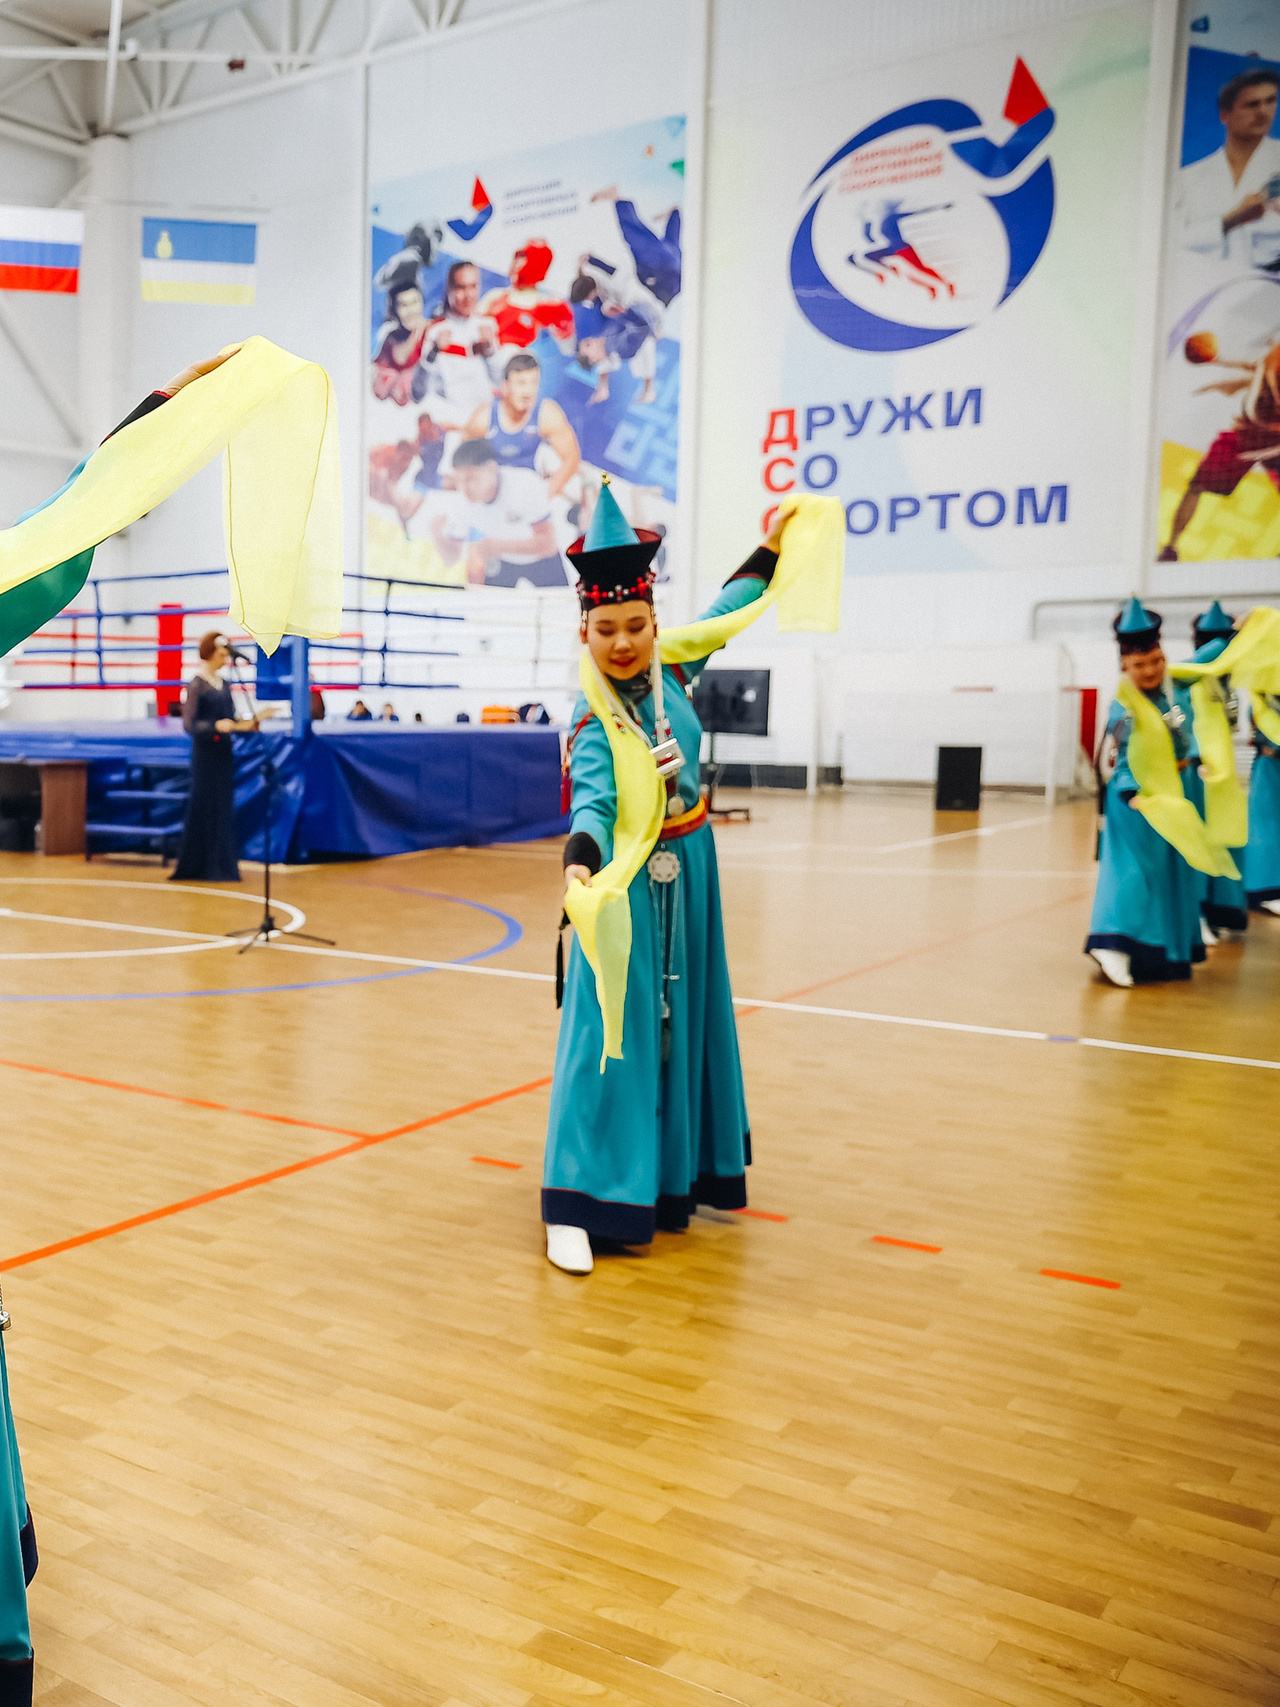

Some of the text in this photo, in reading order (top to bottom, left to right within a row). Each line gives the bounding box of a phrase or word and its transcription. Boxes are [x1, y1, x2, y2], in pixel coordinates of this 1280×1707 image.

[762, 388, 982, 453] ДРУЖИ
[764, 454, 838, 492] СО
[762, 485, 1068, 535] ОРТОМ
